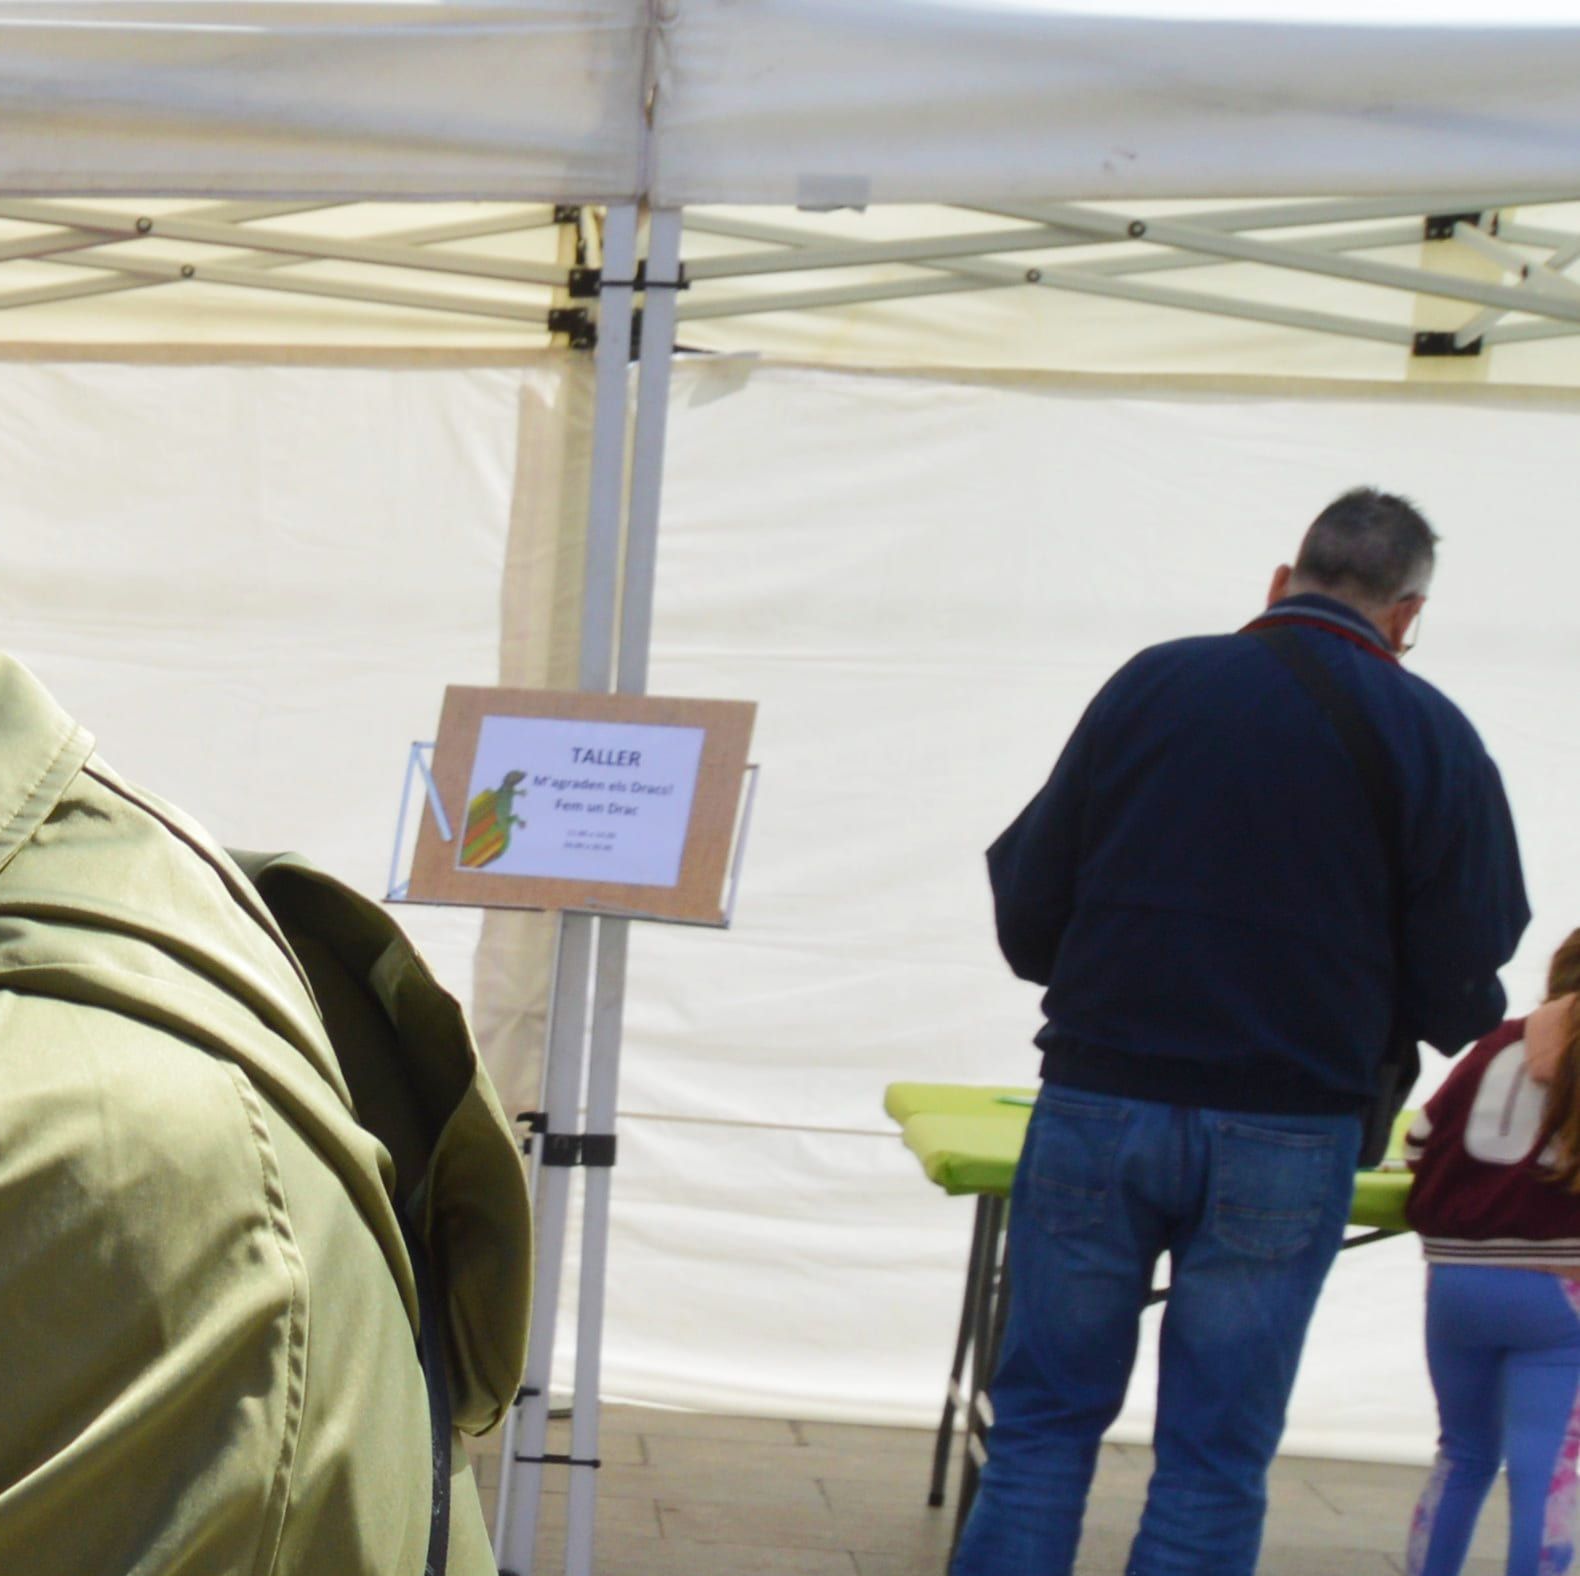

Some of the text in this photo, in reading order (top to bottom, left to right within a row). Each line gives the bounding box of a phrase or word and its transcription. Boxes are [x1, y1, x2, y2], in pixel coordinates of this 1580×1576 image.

[572, 747, 642, 767] TALLER
[609, 780, 626, 793] els
[555, 799, 639, 817] Fem un Drac
